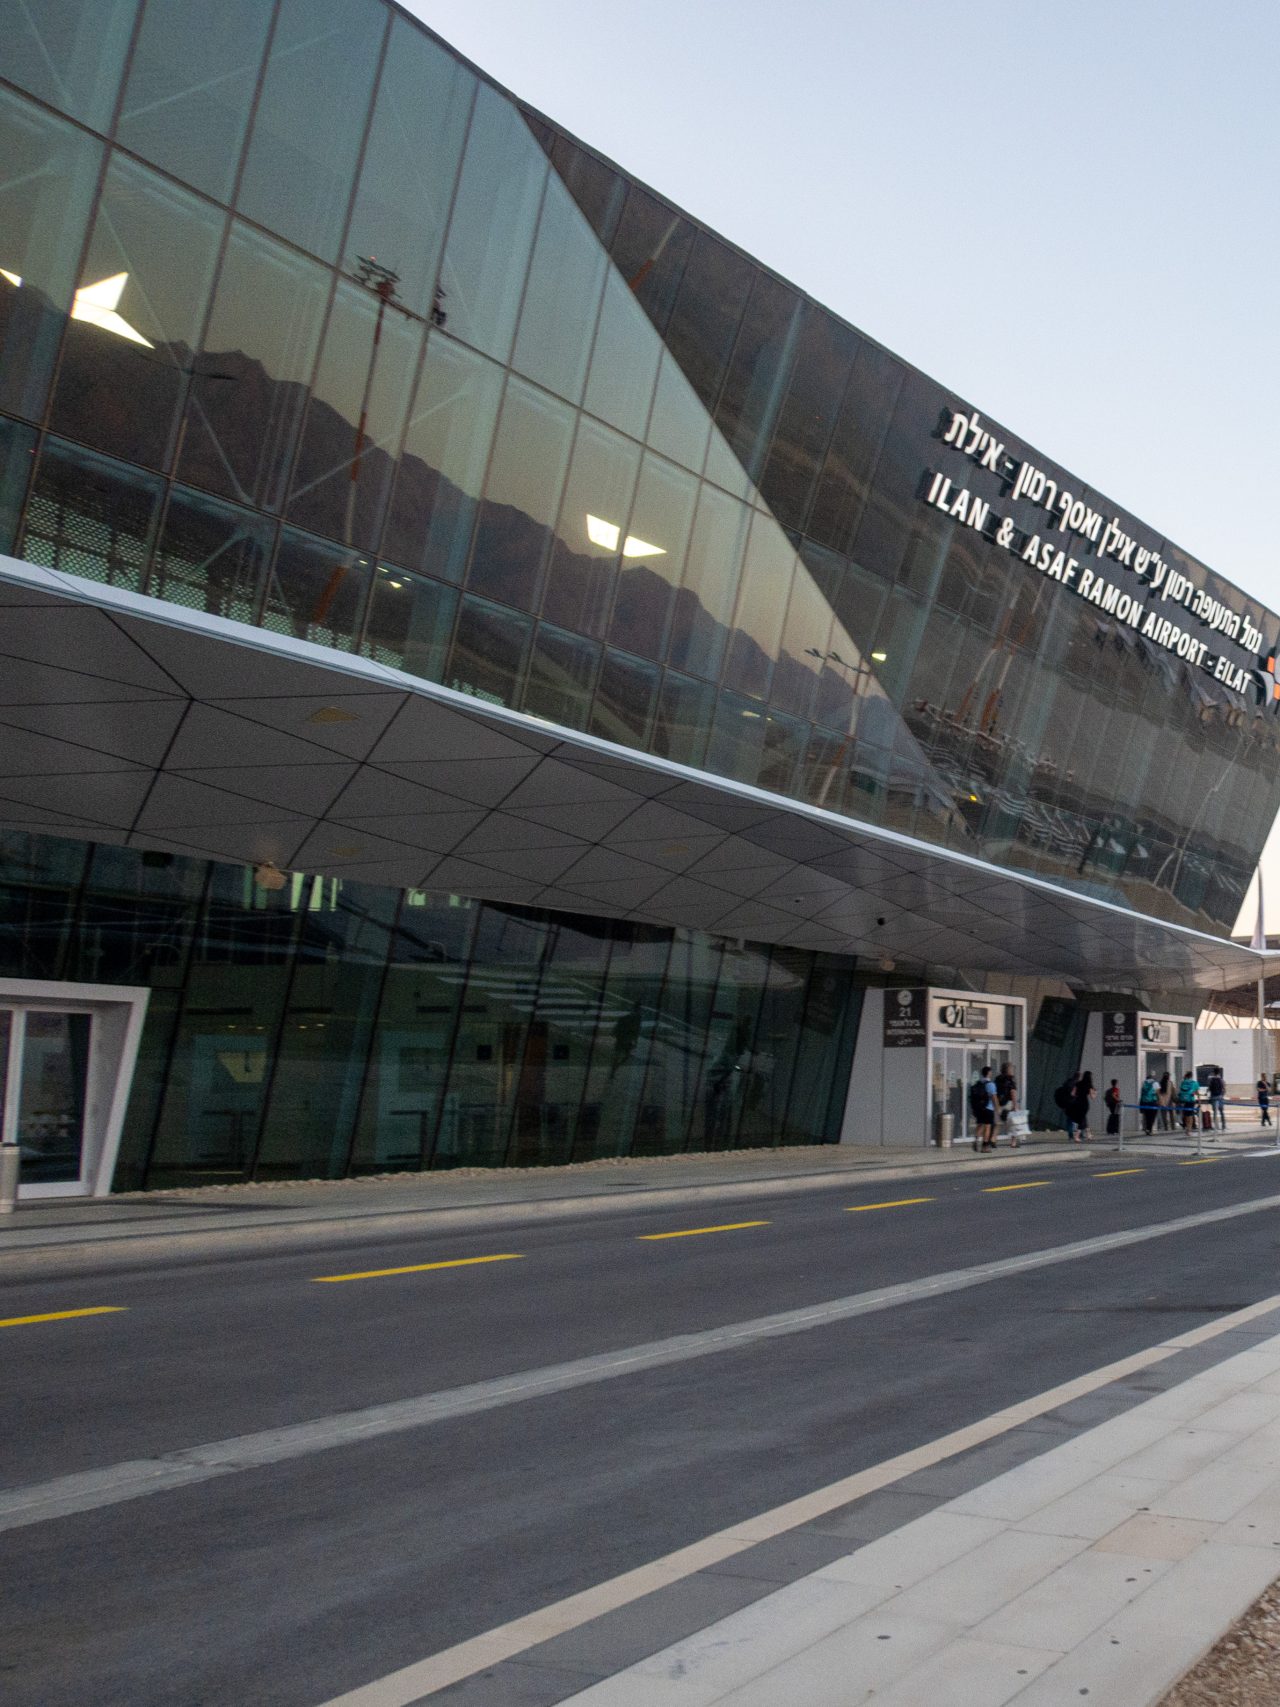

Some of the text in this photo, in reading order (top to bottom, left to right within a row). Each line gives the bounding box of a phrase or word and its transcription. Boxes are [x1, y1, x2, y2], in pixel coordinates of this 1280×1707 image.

[943, 412, 1005, 472] אילת
[1012, 461, 1057, 511] רמון
[1059, 491, 1103, 541] ואסף
[1097, 517, 1137, 566] אילן
[927, 472, 990, 531] ILAN
[996, 517, 1014, 549] &
[1022, 534, 1079, 583] ASAF
[1077, 568, 1144, 628] RAMON
[1141, 611, 1208, 666] AIRPORT
[1213, 656, 1252, 694] EILAT
[1161, 569, 1194, 606] רמון
[1191, 590, 1241, 639] התעופה
[1239, 615, 1263, 654] נמל
[899, 1007, 911, 1017] 21
